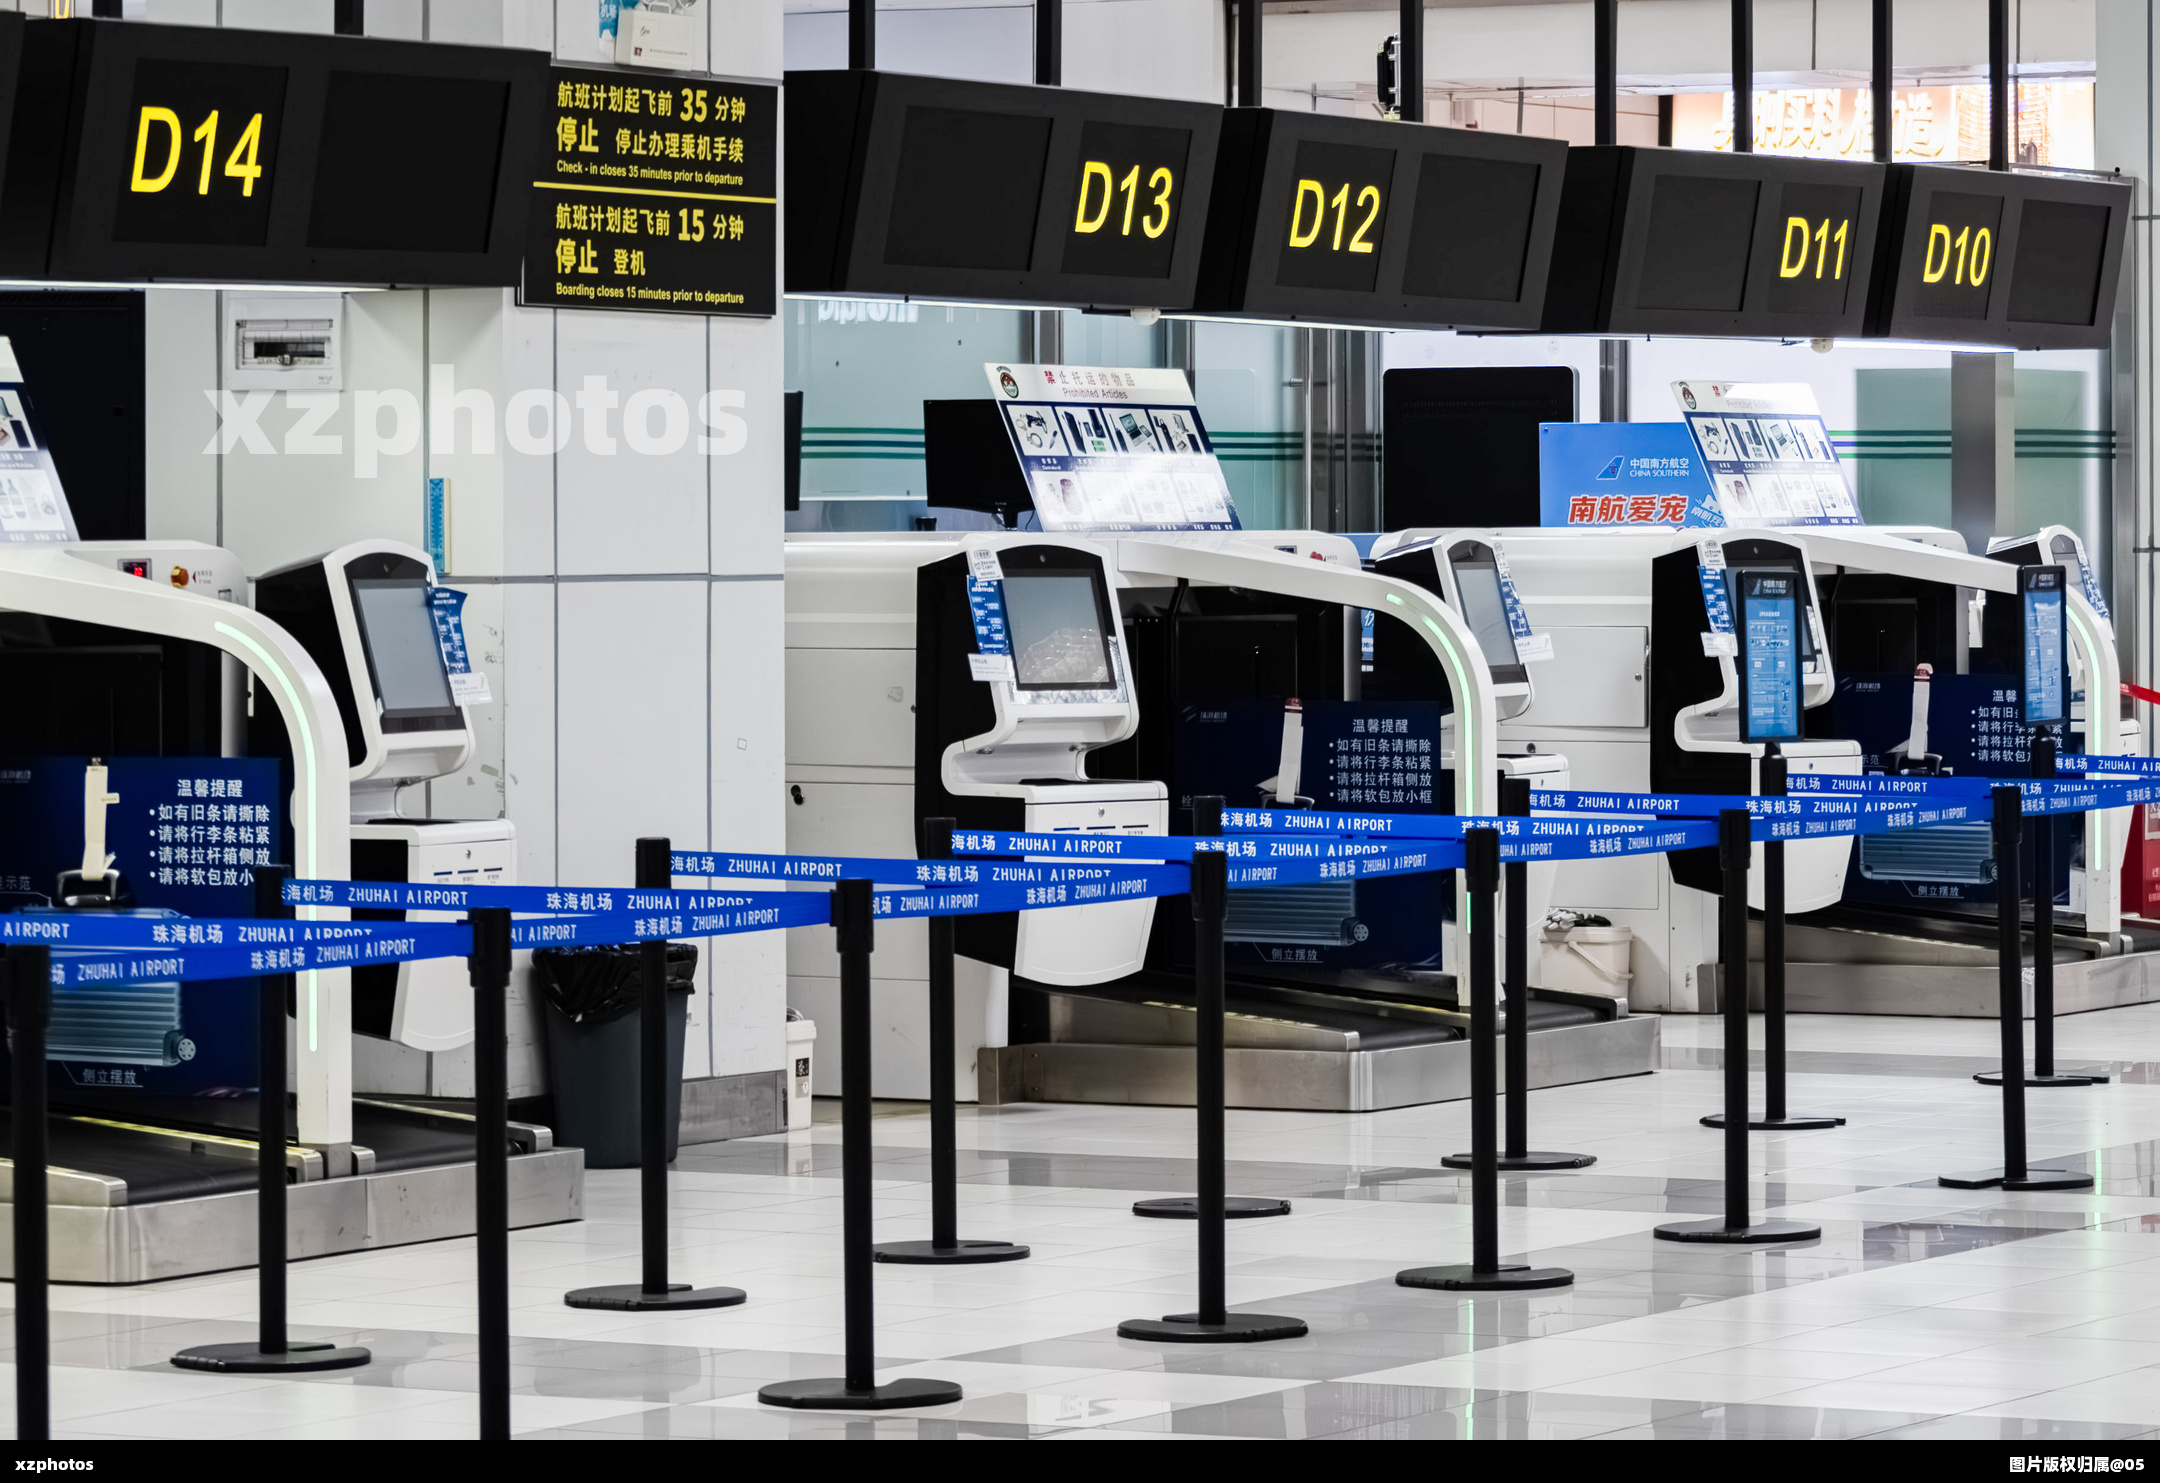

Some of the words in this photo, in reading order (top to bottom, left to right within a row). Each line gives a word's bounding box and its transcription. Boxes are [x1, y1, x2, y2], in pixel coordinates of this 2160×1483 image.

[558, 80, 672, 117] 航班计划起飞前
[680, 88, 707, 123] 35
[715, 96, 746, 123] 分钟
[557, 116, 599, 153] 停止
[616, 128, 744, 163] 停止办理乘机手续
[131, 107, 262, 197] D14
[557, 159, 583, 174] Check
[590, 162, 598, 175] in
[600, 163, 627, 177] closes
[629, 165, 639, 178] 35
[640, 167, 672, 181] minutes
[674, 170, 693, 183] prior
[695, 171, 703, 183] to
[705, 171, 743, 186] departure
[1075, 161, 1172, 238] D13
[556, 202, 670, 236] 航班计划起飞前
[678, 208, 705, 242] 15
[713, 214, 744, 241] 分钟
[1289, 179, 1380, 253] D12
[556, 238, 599, 274] 停止
[614, 249, 646, 276] 登机
[1780, 217, 1848, 279] D11
[1923, 224, 1990, 287] D10
[556, 282, 595, 299] Boarding
[597, 284, 624, 298] closes
[626, 286, 636, 298] 15
[638, 287, 671, 300] minutes
[673, 289, 693, 303] prior
[695, 290, 703, 302] to
[705, 290, 744, 305] departure
[1062, 387, 1099, 398] Prohibited
[1101, 389, 1128, 399] Articles
[1630, 458, 1689, 469] 中国南方航空
[1653, 469, 1689, 477] SOUTHERN
[1569, 494, 1688, 524] 南航爱宠
[1352, 719, 1408, 733] 温馨提醒
[1336, 738, 1431, 753] 如有旧条请撕除
[1336, 754, 1431, 770] 请将行李条粘紧
[2098, 759, 2136, 771] ZHUHAI
[177, 779, 243, 798] 温馨提醒
[1336, 771, 1432, 787] 请将拉杆箱侧放
[1832, 779, 1872, 791] ZHUHAI
[1879, 780, 1928, 793] AIRPORT
[1337, 788, 1432, 804] 请将软包放小框
[1578, 796, 1620, 809] ZHUHAI
[1628, 798, 1680, 811] AIRPORT
[2073, 794, 2098, 807] AIRPORT
[158, 804, 270, 823] 如有旧条请撕除
[1746, 800, 1801, 814] 珠海机场
[1813, 802, 1857, 814] ZHUHAI
[1284, 815, 1330, 829] ZHUHAI
[1337, 818, 1393, 832] AIRPORT
[1532, 822, 1579, 835] ZHUHAI
[1772, 821, 1800, 837] 珠海机场
[1805, 820, 1828, 834] ZHUHAI
[1830, 819, 1857, 832] AIRPORT
[1887, 812, 1914, 828] 珠海机场
[1918, 810, 1939, 823] ZHUHAI
[1941, 807, 1967, 820] AIRPORT
[158, 824, 270, 844] 请将行李条粘紧
[1009, 837, 1056, 852] ZHUHAI
[1064, 839, 1122, 854] AIRPORT
[1270, 843, 1319, 857] ZHUHAI
[1521, 843, 1553, 856] AIRPORT
[1590, 837, 1621, 854] 珠海机场
[1628, 836, 1653, 850] ZHUHAI
[1656, 832, 1686, 847] AIRPORT
[158, 846, 270, 866] 请将拉杆箱侧放
[728, 859, 775, 874] ZHUHAI
[784, 862, 842, 877] AIRPORT
[917, 865, 979, 883] 珠海机场
[992, 867, 1042, 882] ZHUHAI
[1241, 867, 1277, 881] AIRPORT
[1320, 860, 1356, 878] 珠海机场
[1362, 858, 1390, 873] ZHUHAI
[1394, 854, 1427, 869] AIRPORT
[281, 884, 334, 902] 海机场
[348, 888, 398, 903] ZHUHAI
[406, 890, 468, 905] AIRPORT
[547, 892, 613, 911] 珠海机场
[627, 895, 680, 910] ZHUHAI
[900, 895, 934, 911] ZHUHAI
[939, 893, 979, 910] AIRPORT
[1026, 884, 1066, 905] 珠海机场
[1074, 883, 1107, 899] ZHUHAI
[1110, 878, 1148, 895] AIRPORT
[4, 921, 70, 939] AIRPORT
[152, 924, 223, 944] 珠海机场
[238, 926, 294, 943] ZHUHAI
[528, 924, 577, 941] AIRPORT
[635, 916, 683, 937] 珠海机场
[692, 914, 729, 932] ZHUHAI
[735, 908, 780, 927] AIRPORT
[77, 963, 123, 981] ZHUHAI
[130, 958, 185, 977] AIRPORT
[251, 947, 305, 970] 珠海机场
[316, 944, 359, 963] ZHUHAI
[365, 938, 415, 957] AIRPORT
[82, 1069, 136, 1085] 侧立摆放
